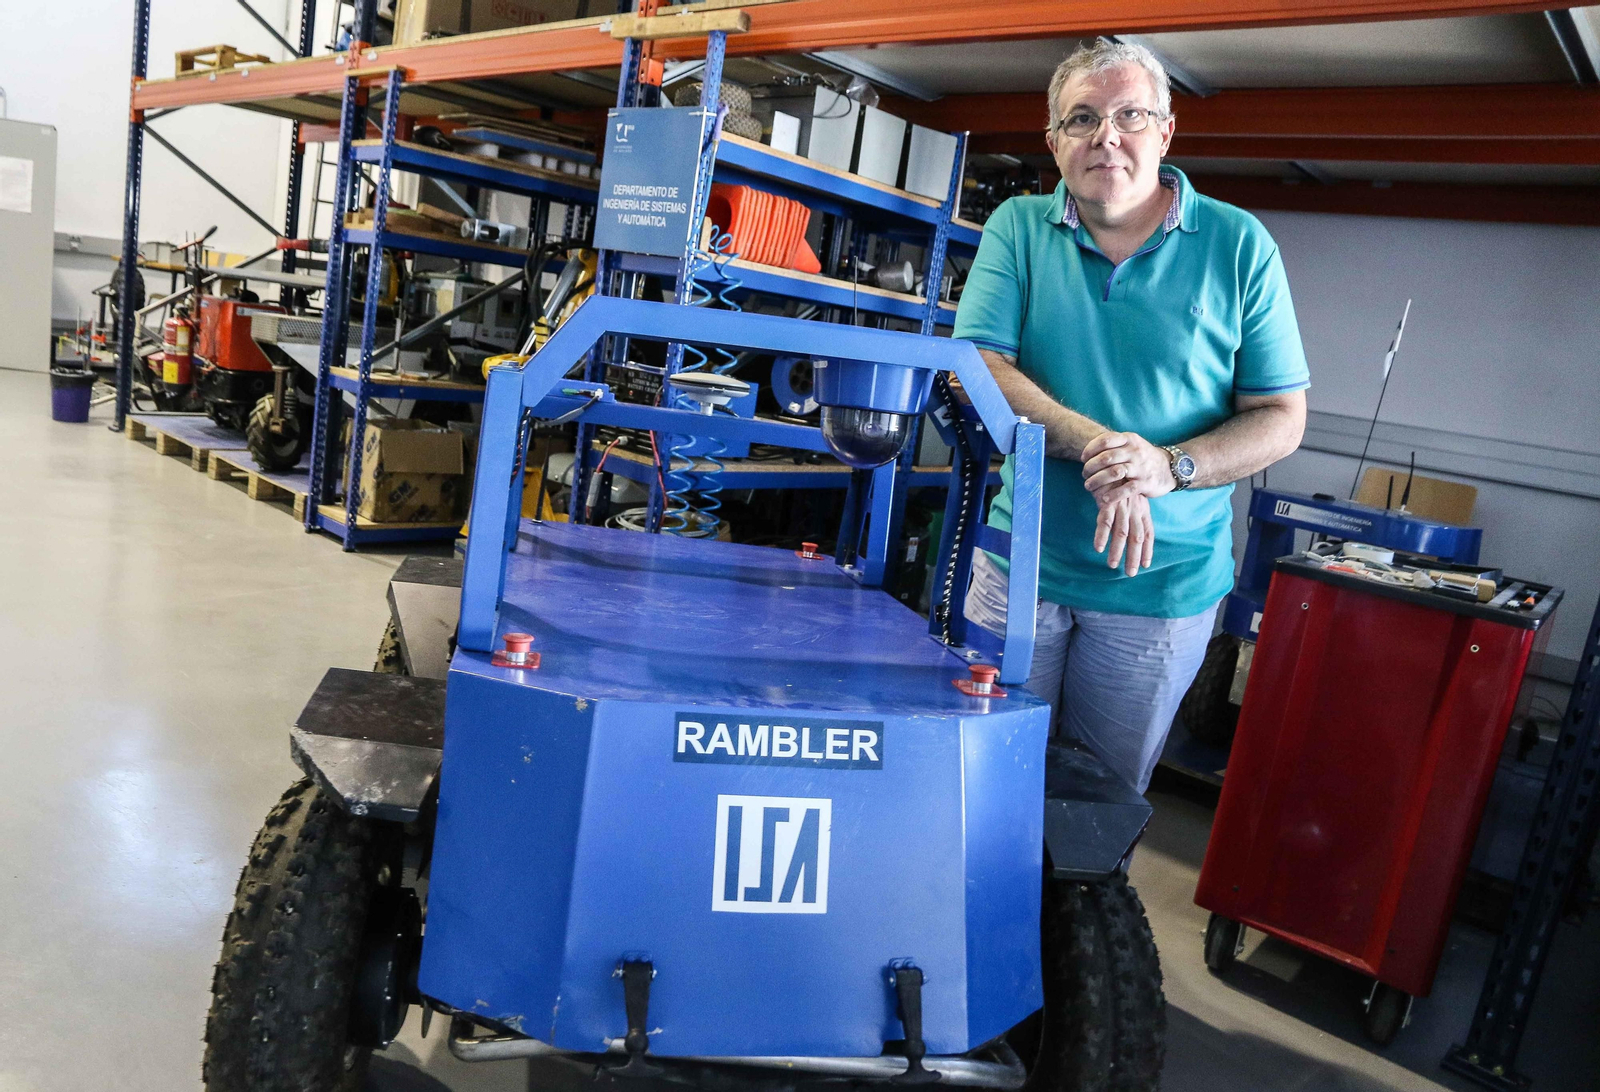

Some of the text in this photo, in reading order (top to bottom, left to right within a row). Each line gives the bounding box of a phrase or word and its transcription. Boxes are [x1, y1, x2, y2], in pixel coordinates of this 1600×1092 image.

[613, 184, 679, 198] DEPARTAMENTO DE
[603, 198, 687, 214] INGENIERÍA DE SISTEMAS
[617, 213, 666, 228] Y AUTOMÁTICA
[677, 721, 879, 762] RAMBLER
